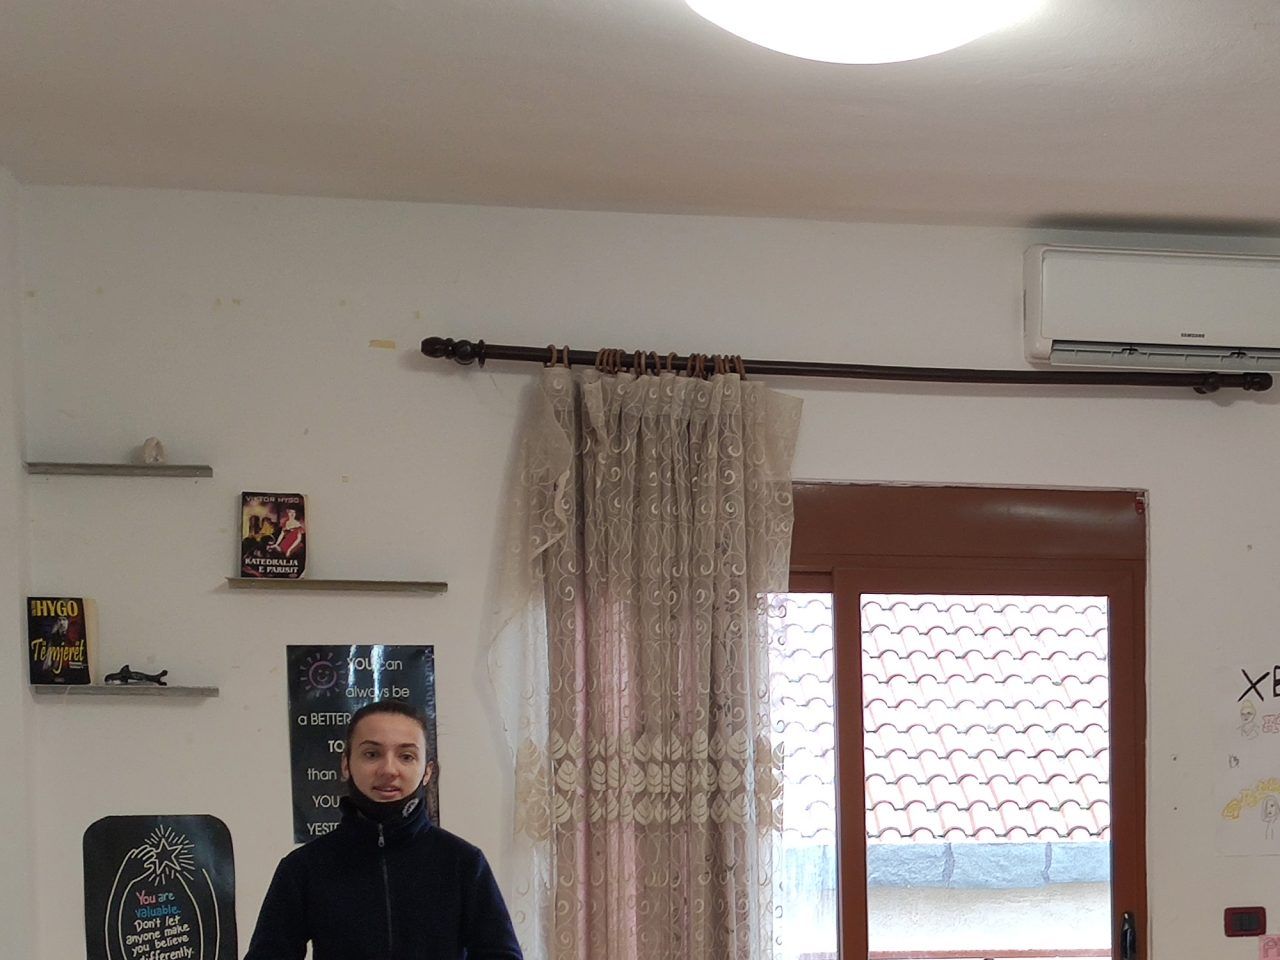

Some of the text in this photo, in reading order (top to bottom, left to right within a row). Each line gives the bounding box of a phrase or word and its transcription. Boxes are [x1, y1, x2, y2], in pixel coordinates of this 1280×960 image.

[36, 600, 78, 617] HYGO
[31, 638, 85, 674] Të mjerët
[347, 657, 372, 671] YOU
[392, 685, 410, 698] be
[297, 713, 351, 726] a BETTER
[328, 740, 345, 753] TO
[307, 768, 337, 780] than
[312, 795, 340, 808] YOU
[136, 890, 175, 905] You are
[134, 915, 180, 932] Don't let
[126, 924, 190, 945] anyone make
[132, 934, 189, 957] you believe
